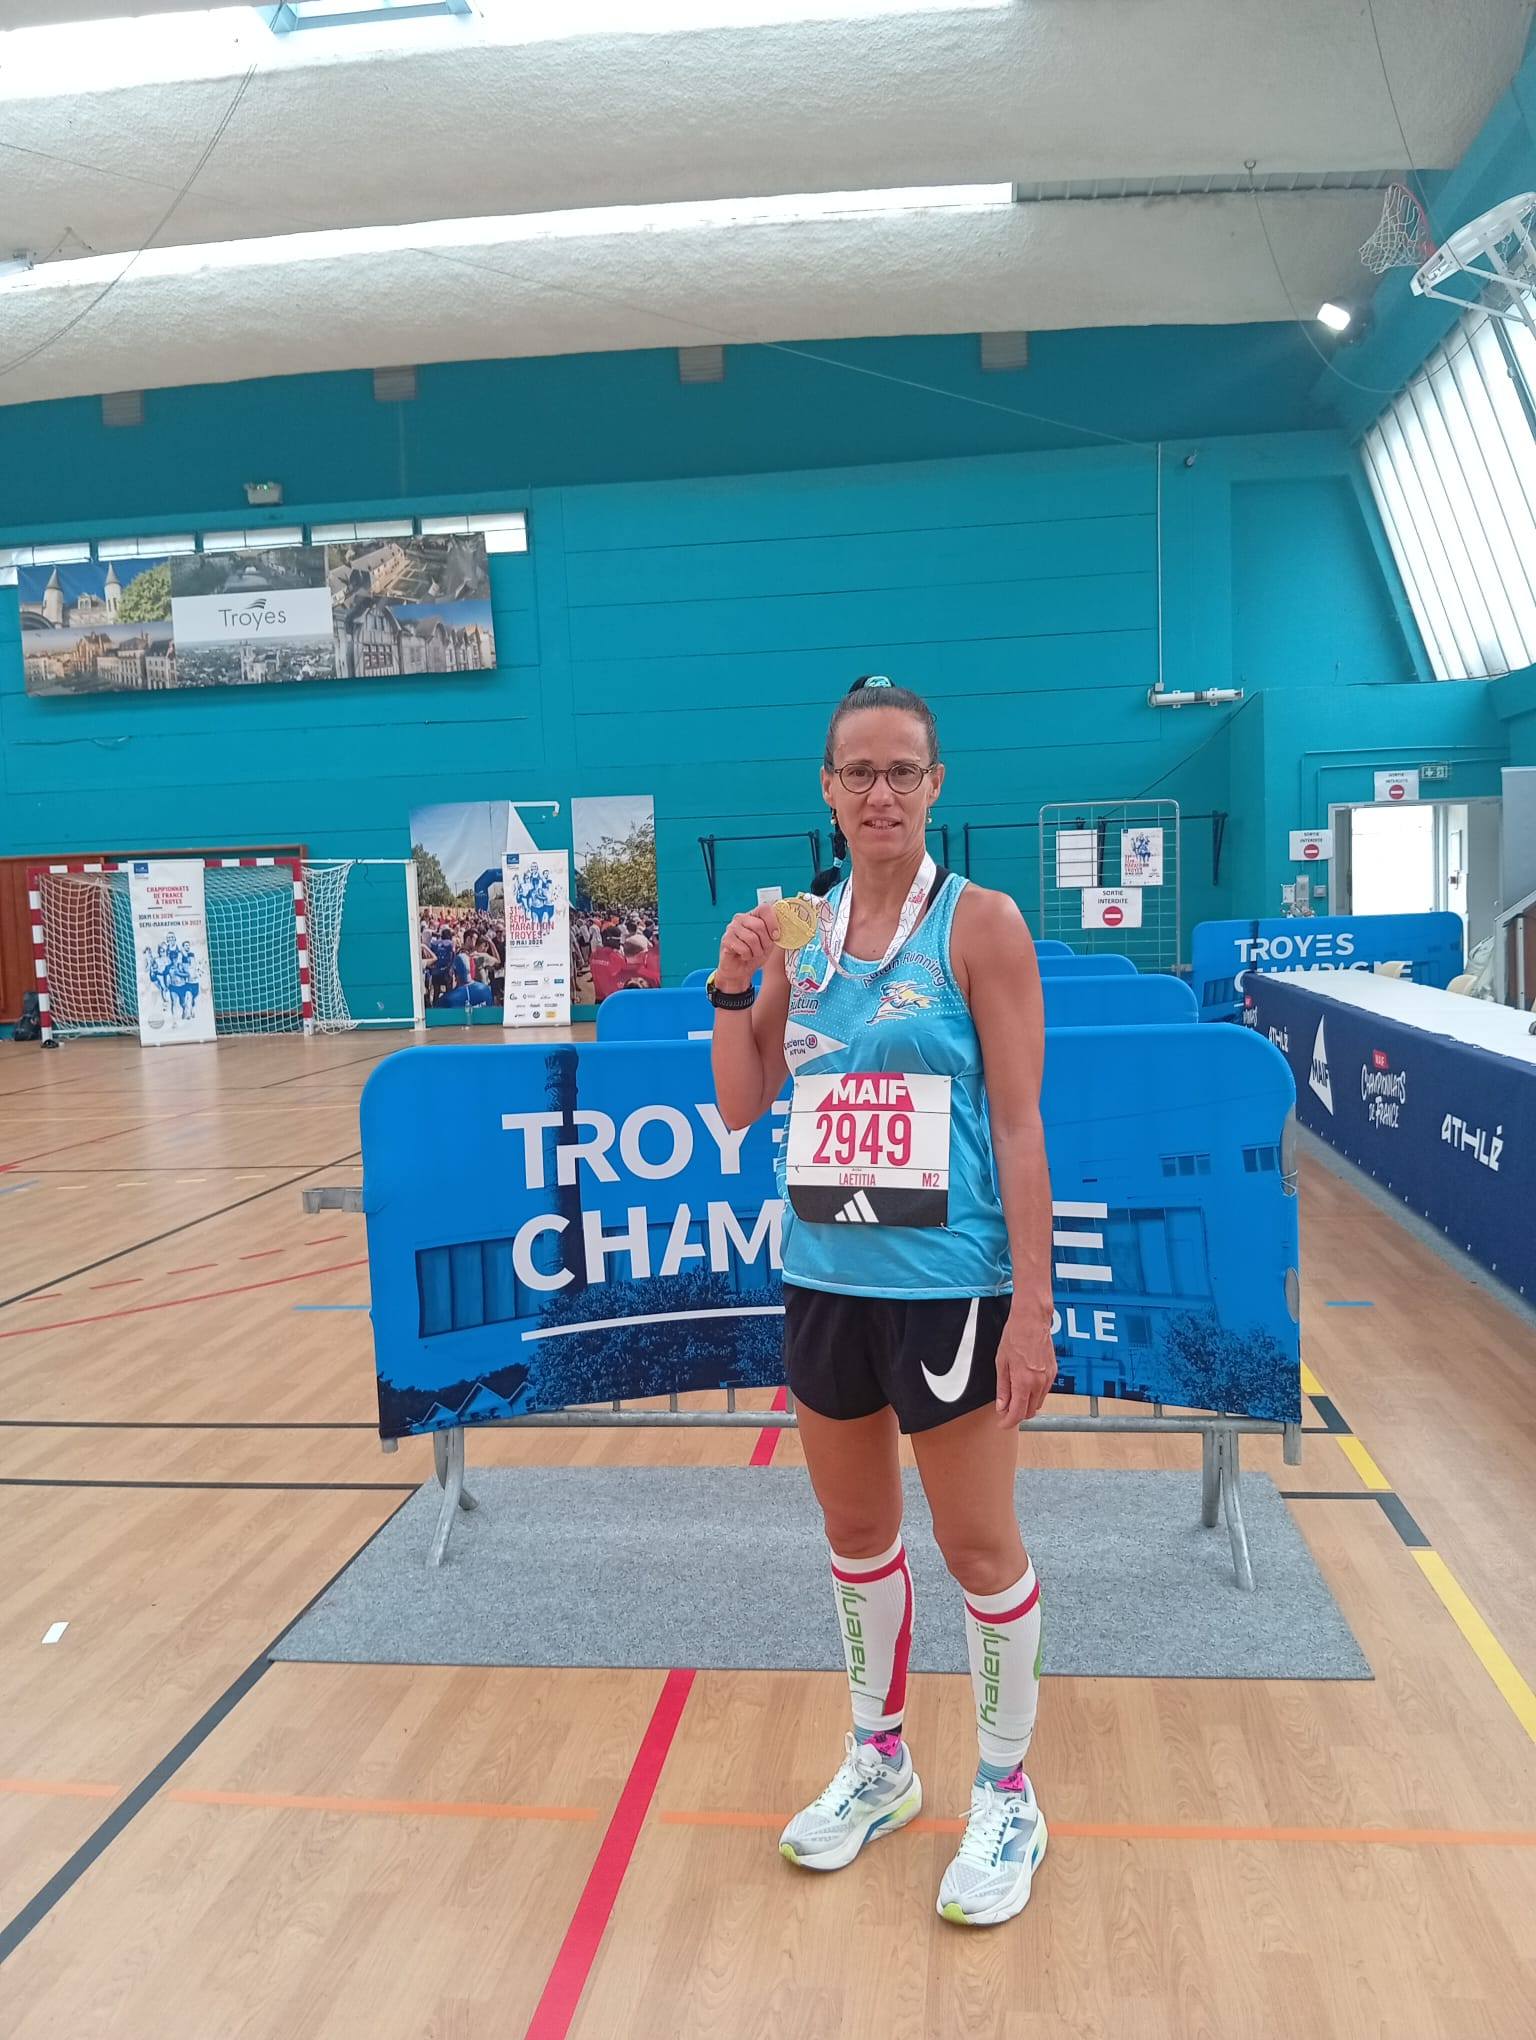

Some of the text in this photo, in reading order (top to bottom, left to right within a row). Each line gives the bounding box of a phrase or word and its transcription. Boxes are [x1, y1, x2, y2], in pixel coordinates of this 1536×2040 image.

[218, 608, 287, 632] Troyes
[146, 885, 190, 893] CHAMPIONNATS
[139, 921, 181, 929] SEMI-MARATHON
[510, 930, 543, 940] TROYES
[1233, 932, 1355, 963] TROYES
[904, 951, 947, 987] Running
[831, 1078, 908, 1106] MAIF
[812, 1112, 913, 1167] 2949
[1441, 1113, 1505, 1173] ATHLÉ
[838, 1172, 941, 1188] LAETITIA M2
